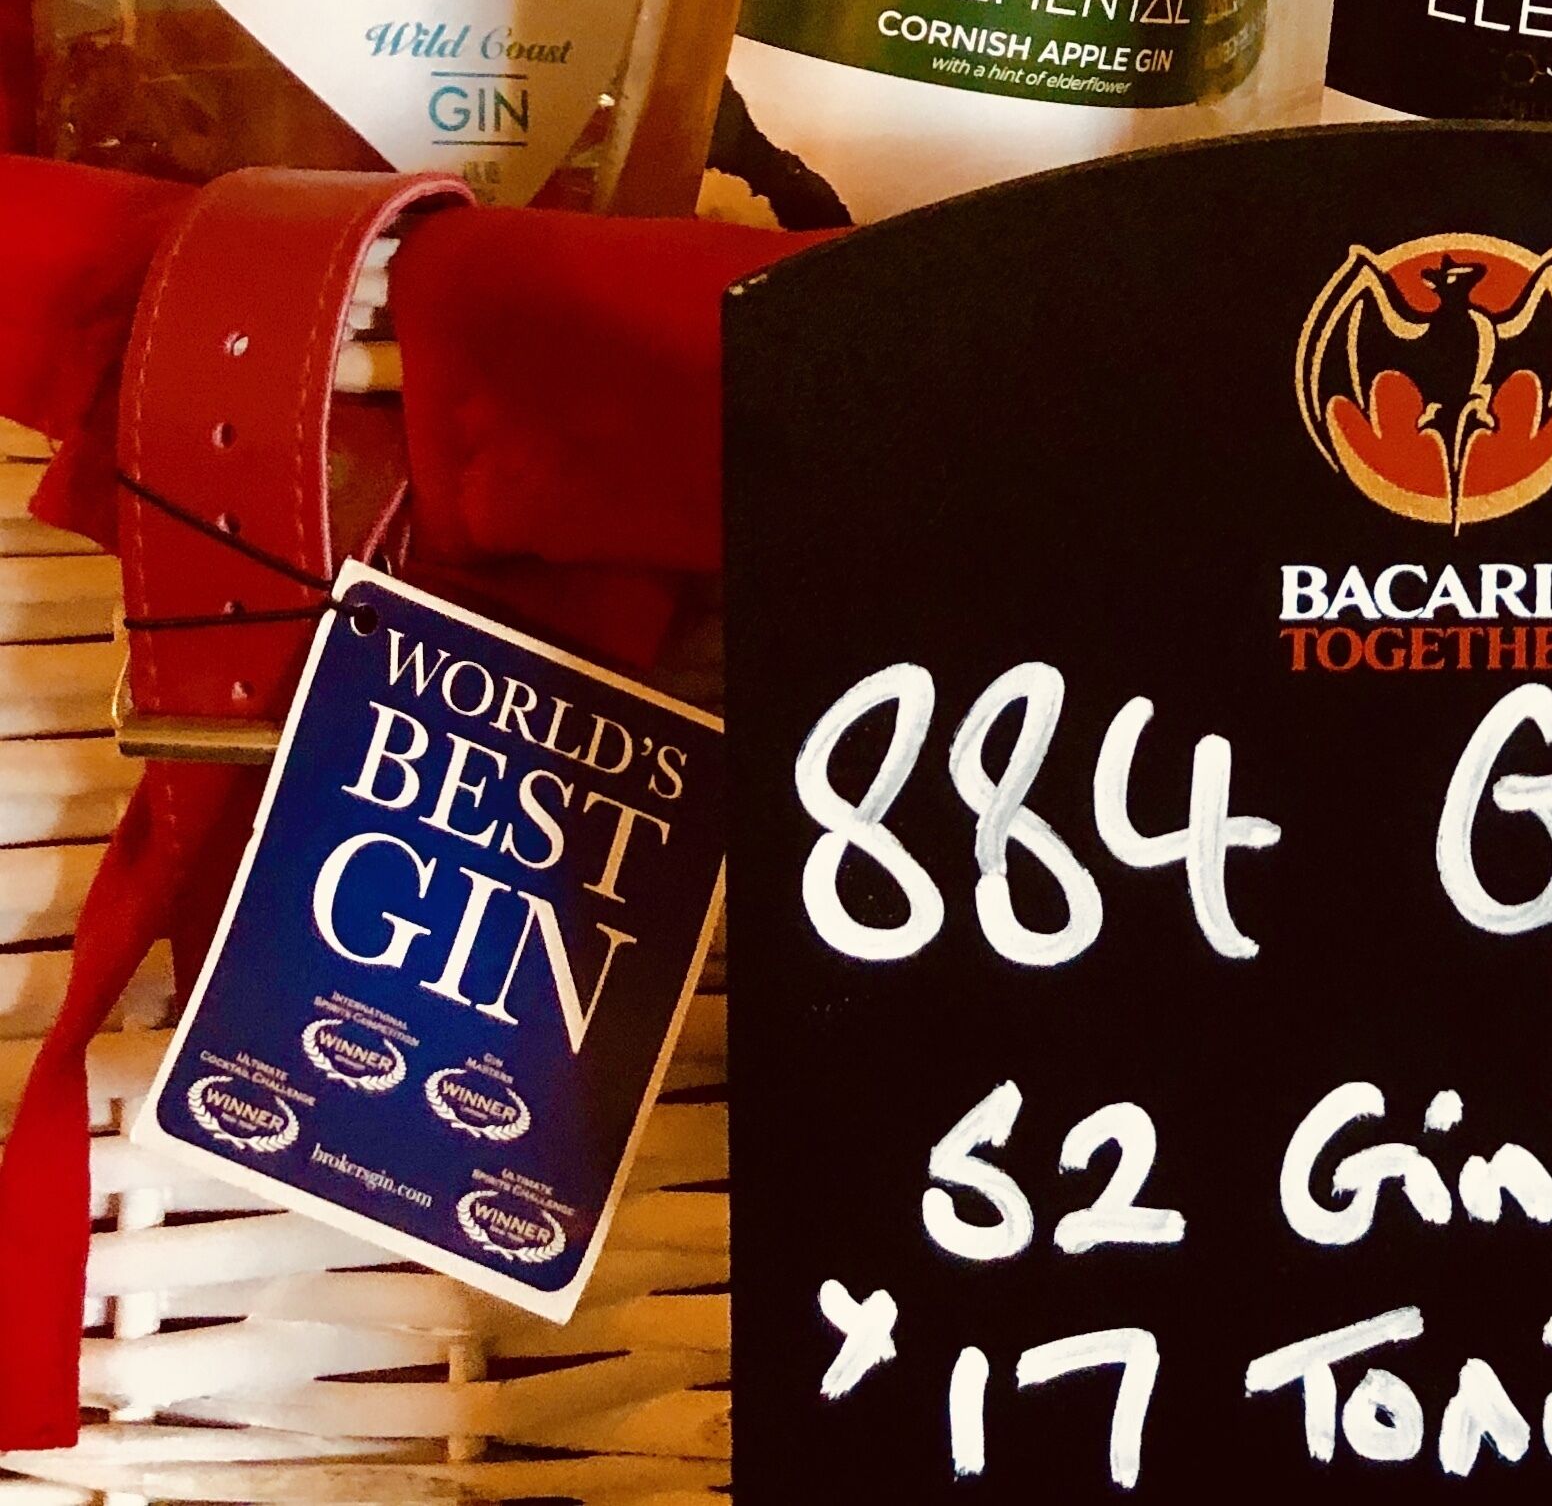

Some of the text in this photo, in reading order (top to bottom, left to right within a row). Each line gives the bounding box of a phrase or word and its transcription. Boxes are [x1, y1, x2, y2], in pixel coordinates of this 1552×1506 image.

[364, 20, 573, 65] Wild Coast
[877, 8, 1174, 74] CORNISH APPLE GIN
[932, 54, 1132, 96] with a hint of elderflower
[428, 85, 530, 134] GIN
[385, 627, 689, 800] WORLD'S
[341, 700, 671, 905] BEST
[794, 661, 1283, 968] 884
[312, 831, 638, 1056] GIN
[199, 1049, 317, 1108] COCKTAIL CHALLENGE
[235, 1051, 290, 1082] ULTIMATE
[318, 1029, 394, 1072] WINNER
[205, 1087, 285, 1133] WINNER
[441, 1079, 518, 1124] WINNER
[310, 1142, 434, 1210] brokersgin.com
[920, 1078, 1188, 1262] 52
[475, 1201, 553, 1245] WINNER
[948, 1326, 1161, 1490] 17
